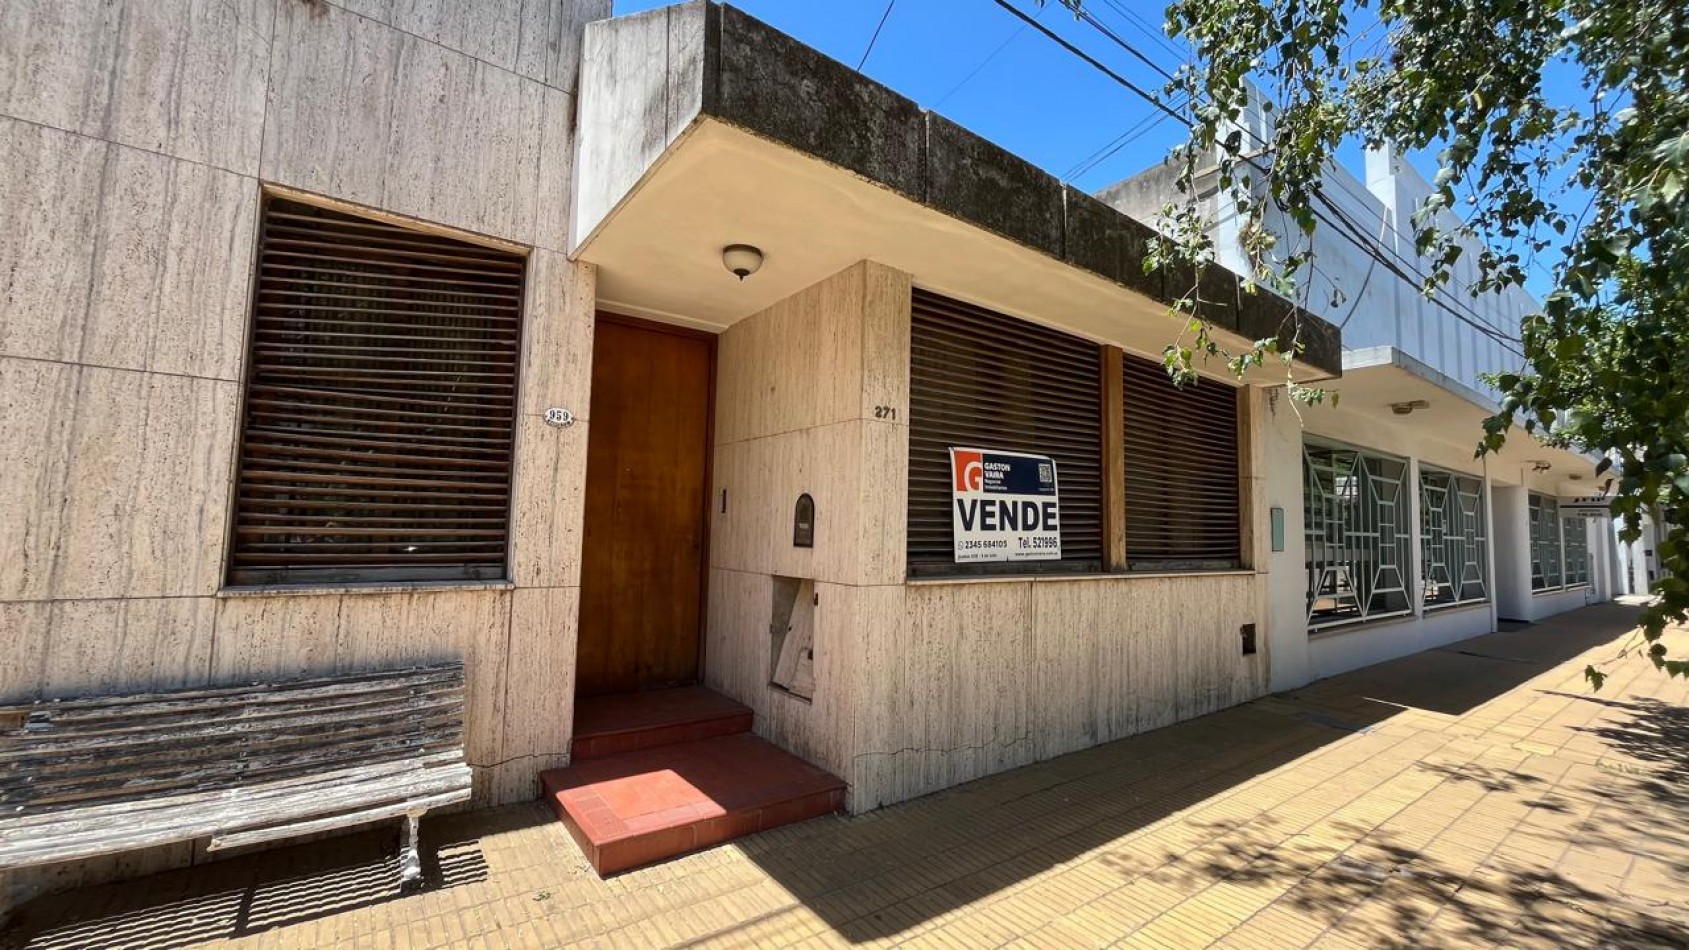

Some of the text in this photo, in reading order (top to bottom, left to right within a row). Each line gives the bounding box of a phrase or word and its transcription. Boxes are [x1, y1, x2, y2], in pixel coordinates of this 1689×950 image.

[549, 410, 569, 421] 959
[875, 405, 896, 421] 271
[984, 462, 1011, 471] GASTON
[956, 498, 1058, 531] VENDE
[965, 540, 983, 549] 2345
[1018, 537, 1031, 549] Tel.
